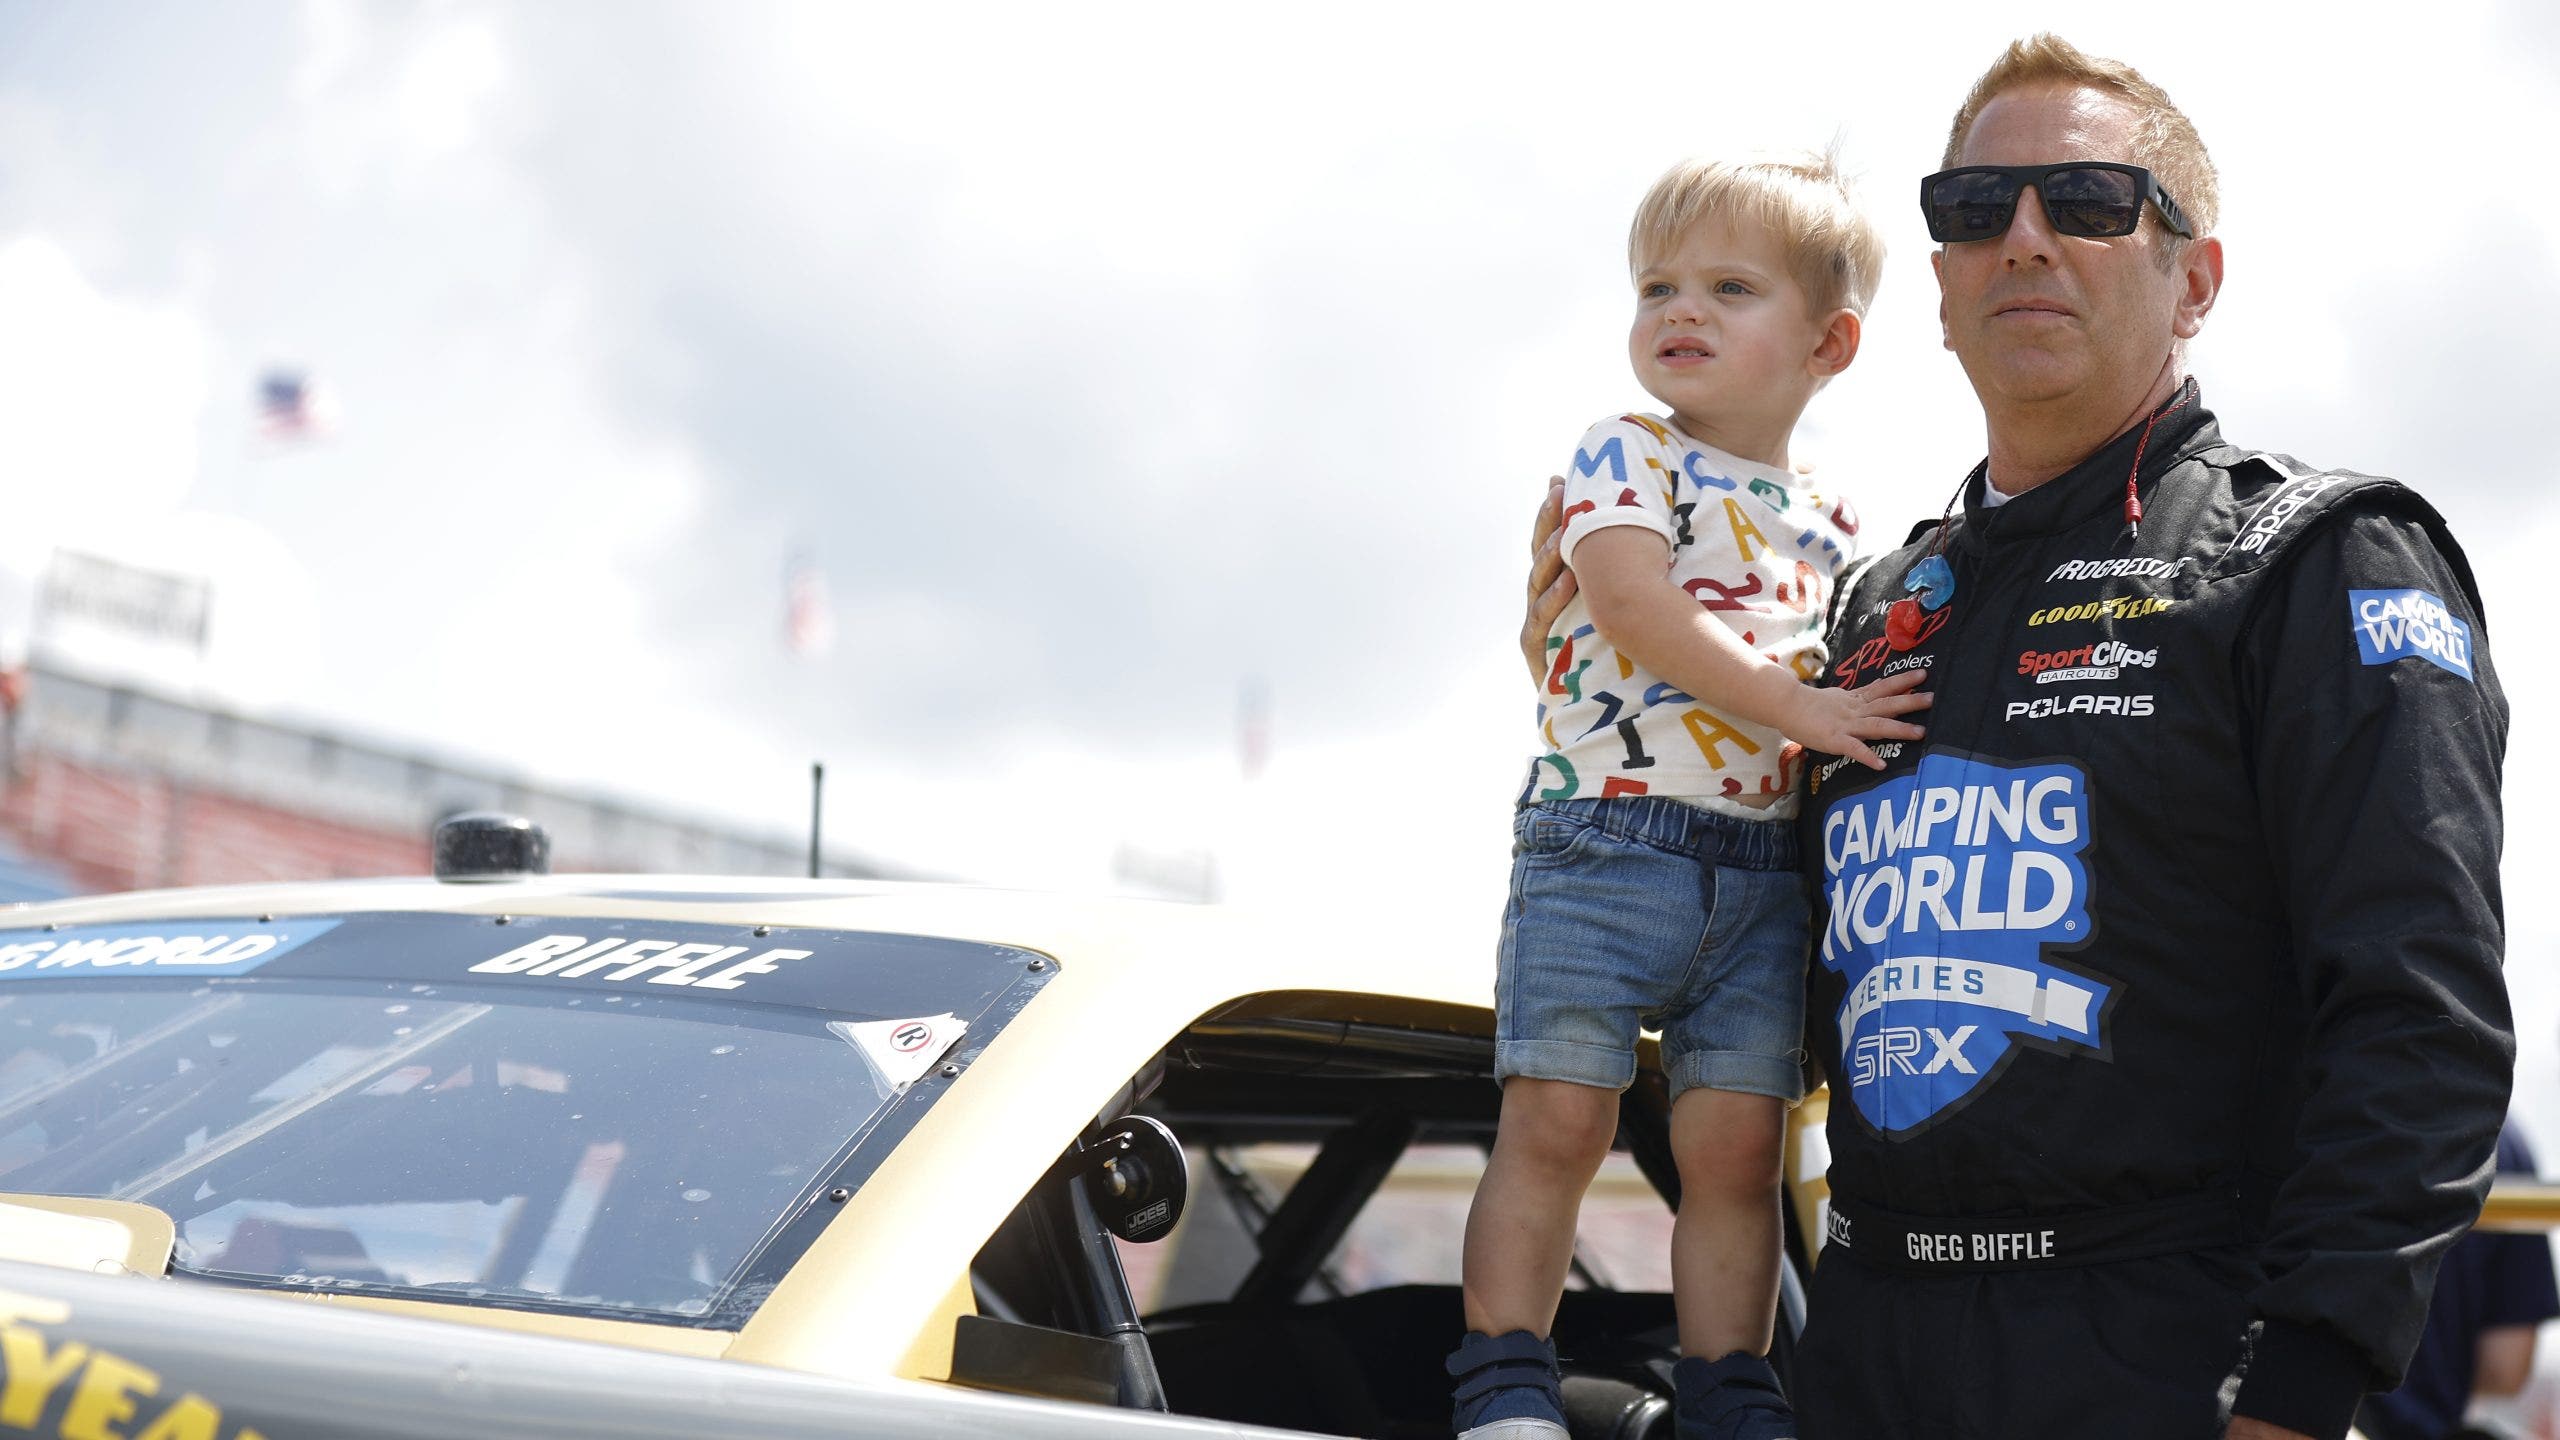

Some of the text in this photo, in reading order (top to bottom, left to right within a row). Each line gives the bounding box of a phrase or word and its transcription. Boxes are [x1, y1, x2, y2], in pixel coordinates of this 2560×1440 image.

[2240, 475, 2348, 555] sparco
[2027, 595, 2176, 627] GOODYEAR
[2017, 640, 2158, 677] SportClips
[2364, 617, 2470, 672] WORL
[1883, 654, 1934, 677] coolers
[2039, 667, 2119, 684] HAIRCUTS
[2005, 694, 2156, 722] POLARIS
[1824, 775, 2078, 877] CAMPING
[1822, 851, 2073, 962] WORLD
[36, 934, 278, 969] WORLD
[467, 935, 815, 990] BIFFLE
[1853, 1025, 1980, 1088] SRX
[1128, 1202, 1167, 1229] JOES
[1906, 1230, 2056, 1262] GREG BIFFLE
